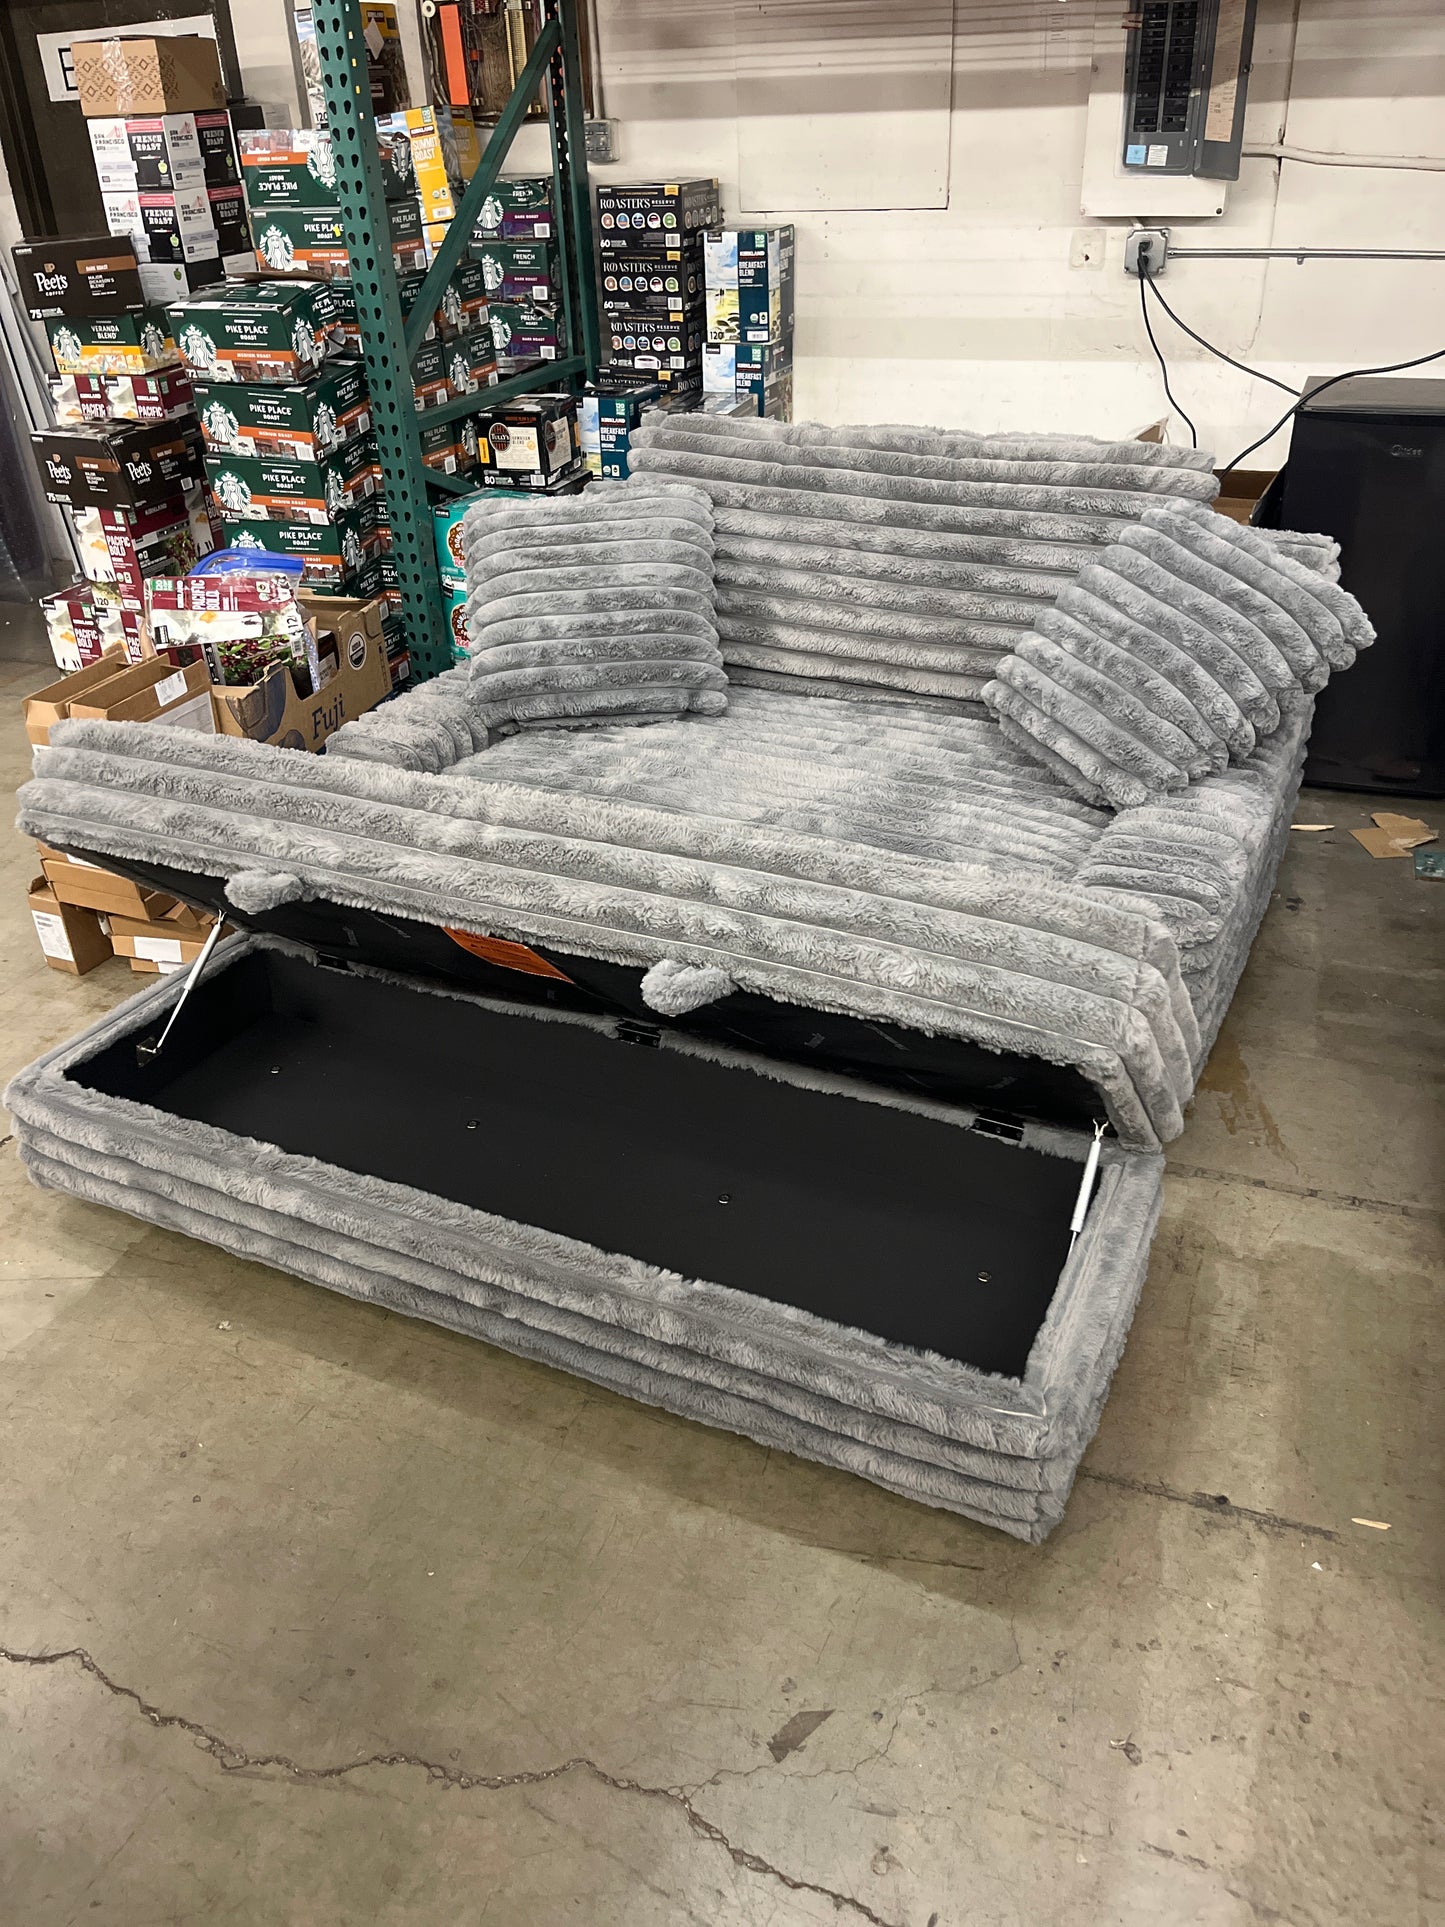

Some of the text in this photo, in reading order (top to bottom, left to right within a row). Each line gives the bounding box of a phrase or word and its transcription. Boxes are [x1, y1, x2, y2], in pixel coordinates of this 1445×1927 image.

[203, 130, 225, 138] FRENCH
[132, 135, 162, 144] FRENCH
[206, 138, 224, 146] ROAST
[412, 137, 439, 150] SUMMIT
[136, 143, 161, 151] ROAST
[415, 149, 436, 161] ROAST
[258, 182, 298, 191] PIKE PLACE
[216, 201, 239, 210] FRENCH
[600, 198, 651, 210] ROASTER'S
[145, 209, 174, 217] FRENCH
[220, 209, 238, 218] ROAST
[149, 217, 173, 225] ROAST
[392, 213, 417, 224] PIKE PLACE
[304, 224, 320, 232] PIKE
[473, 231, 482, 239] 72
[600, 240, 611, 248] 60
[603, 262, 653, 273] ROASTER'S
[739, 261, 766, 269] BREAKFAST
[739, 269, 755, 277] BLEND
[34, 272, 69, 292] Peet's
[471, 274, 481, 283] PLACE
[402, 290, 412, 298] PIKE
[333, 299, 356, 307] PLACE
[604, 301, 614, 309] 60
[30, 309, 43, 320] 75
[225, 325, 267, 334] PIKE PLACE
[97, 332, 117, 340] BLEND
[710, 332, 723, 340] 120
[479, 341, 490, 350] PLACE
[417, 356, 439, 369] PIKE PLACE
[186, 369, 198, 378] 72
[736, 372, 762, 381] BREAKFAST
[337, 380, 360, 399] PIKE PLACE
[138, 406, 163, 418] PACIFIC
[249, 404, 291, 415] PIKE PLACE
[434, 426, 447, 436] PLACE
[601, 434, 616, 442] BLEND
[208, 443, 220, 452] 72
[316, 450, 325, 460] 72
[46, 460, 72, 480] Peet's
[126, 462, 152, 481] Peet's
[262, 474, 305, 484] PIKE PLACE
[485, 476, 495, 485] 80
[46, 492, 56, 502] 75
[220, 510, 232, 519] 72
[298, 532, 321, 541] PLACE
[106, 536, 131, 548] PACIFIC
[109, 546, 126, 557] BOLD
[191, 579, 206, 611] PACIFIC
[96, 597, 109, 606] 120
[206, 590, 221, 611] BOLD
[75, 628, 98, 641] PACIFIC
[77, 638, 93, 649] BOLD
[312, 693, 346, 740] Fuji
